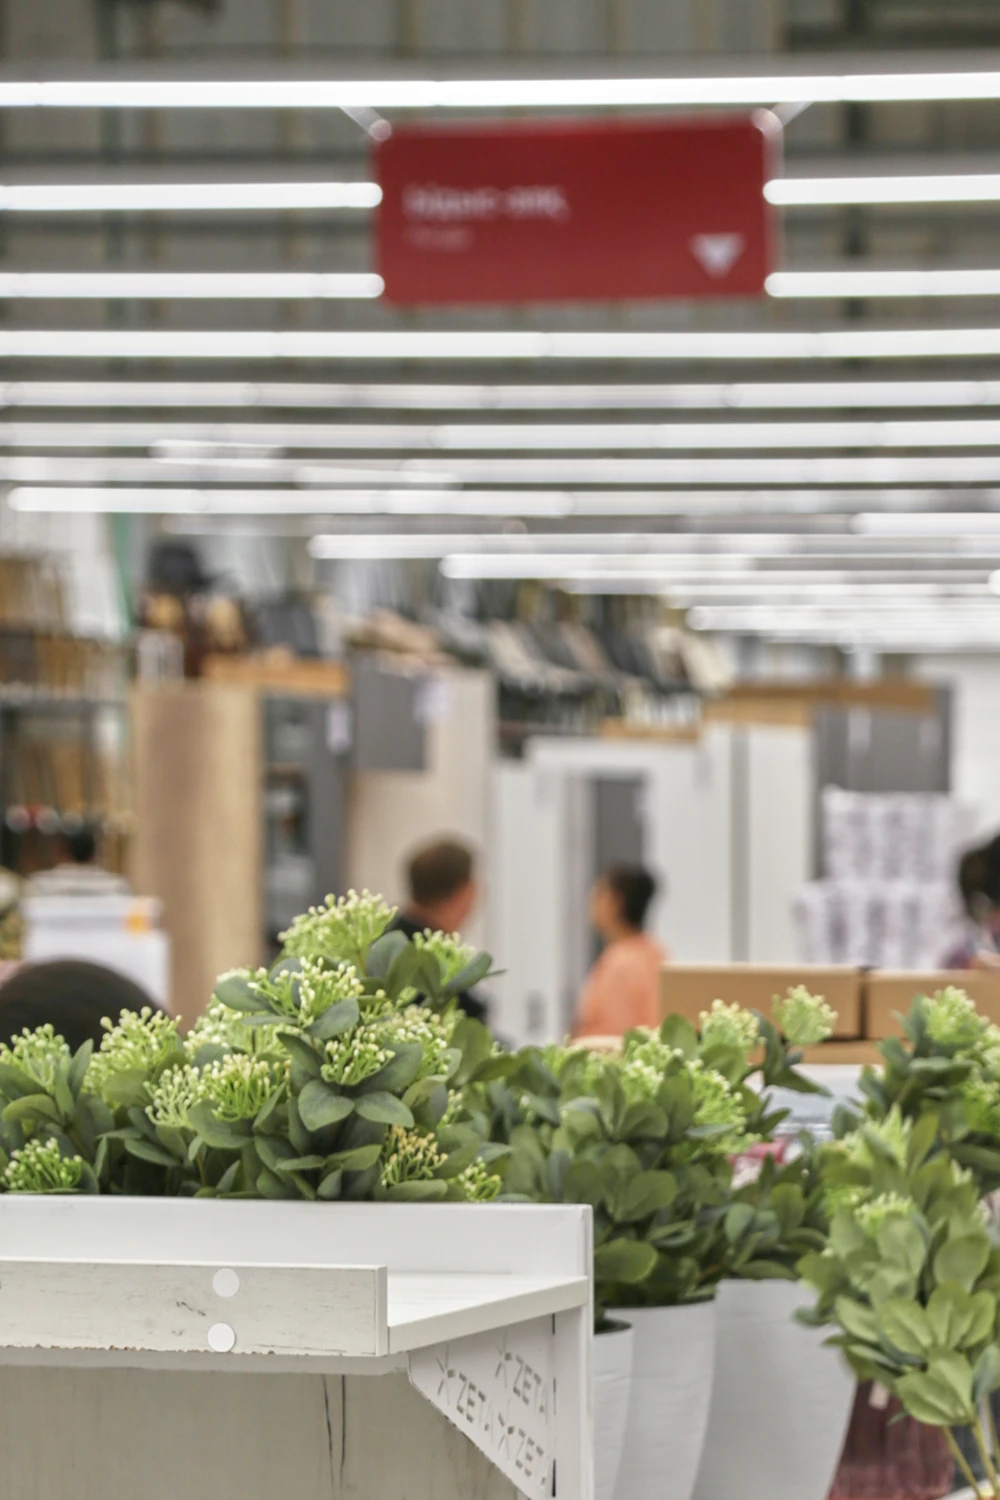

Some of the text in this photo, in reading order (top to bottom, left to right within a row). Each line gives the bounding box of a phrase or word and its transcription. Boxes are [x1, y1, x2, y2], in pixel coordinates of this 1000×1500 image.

[456, 1371, 549, 1489] ZETA ZETA
[513, 1354, 548, 1425] ZETA
